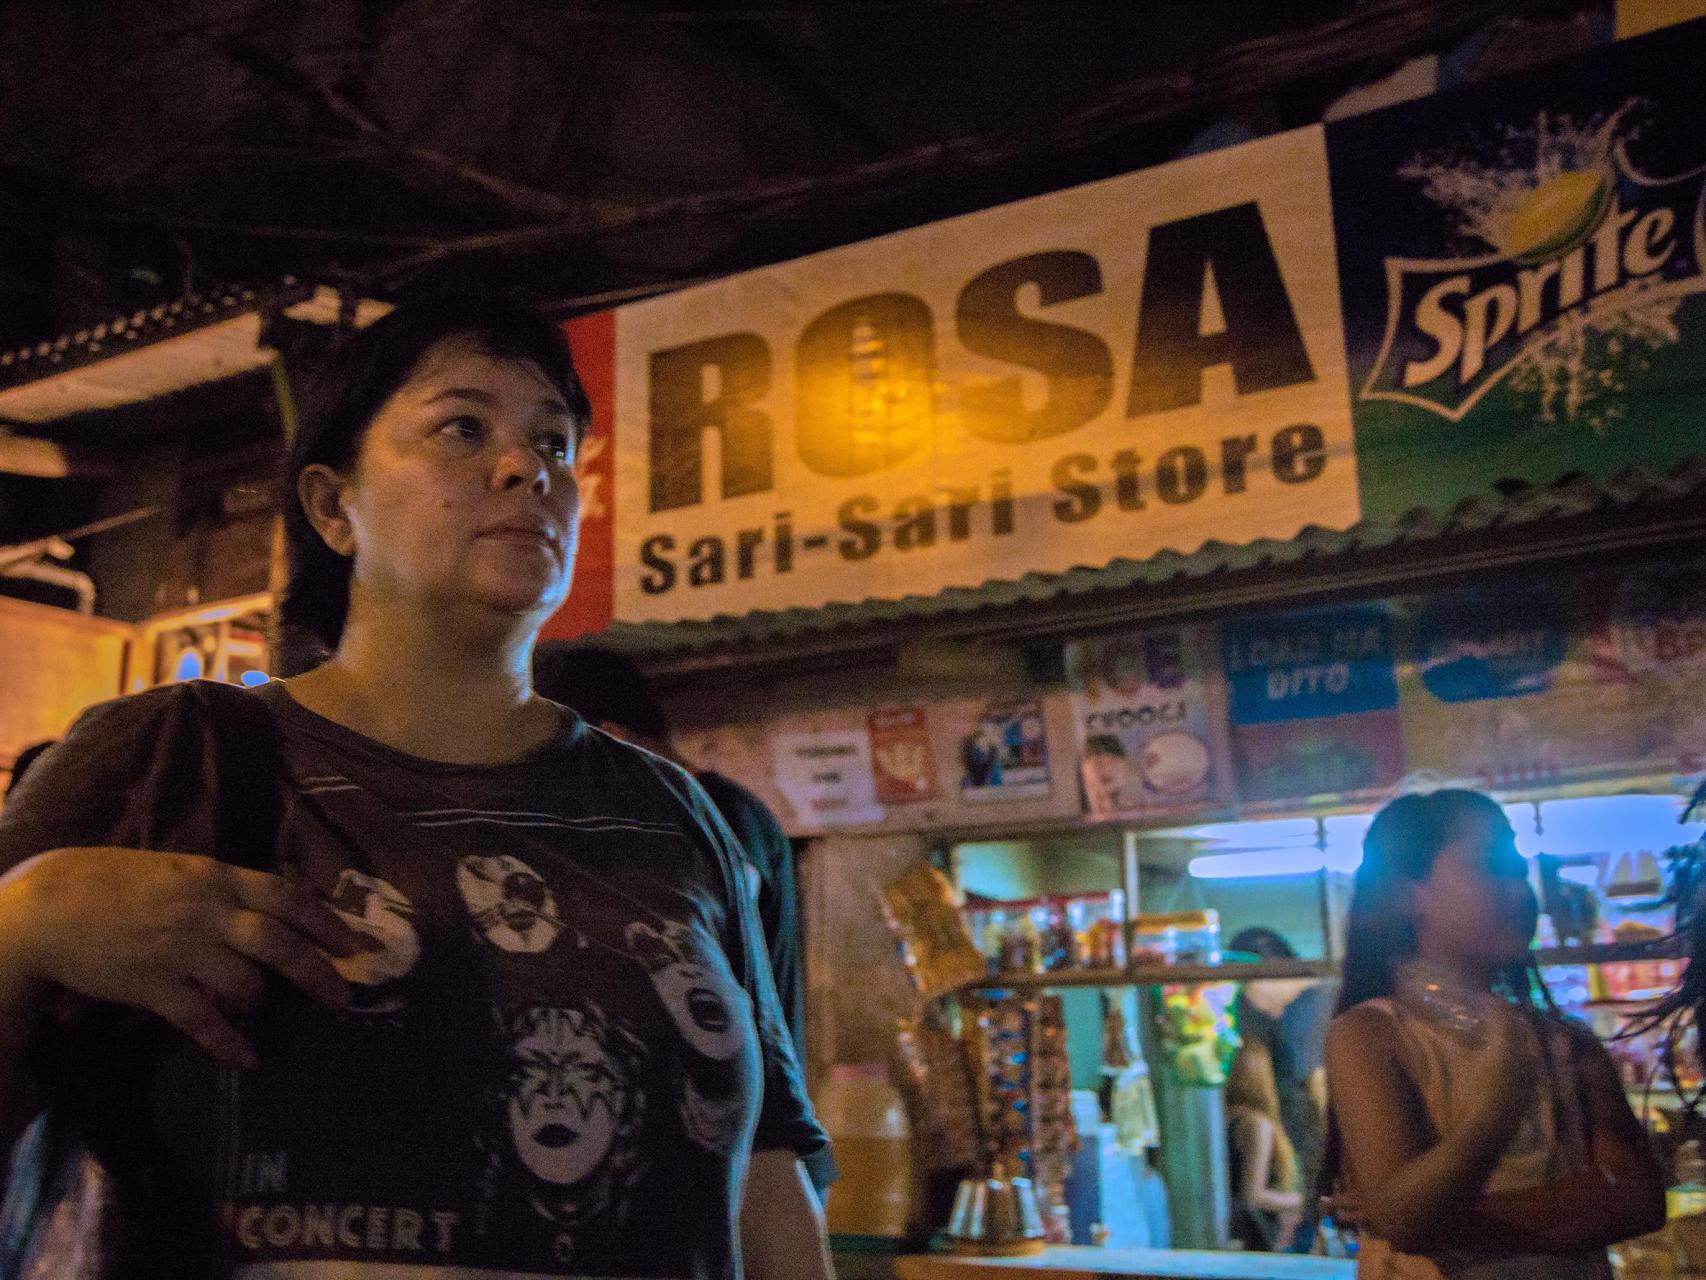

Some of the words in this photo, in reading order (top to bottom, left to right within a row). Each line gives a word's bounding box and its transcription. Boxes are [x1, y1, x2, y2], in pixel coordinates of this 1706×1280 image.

[1404, 196, 1676, 387] Sprite
[648, 201, 1317, 513] ROSA
[640, 468, 1015, 596] Sari-Sari
[1052, 422, 1327, 523] Store
[1266, 662, 1350, 700] DITO
[237, 1203, 461, 1251] CONCERT
[239, 1151, 288, 1195] IN
